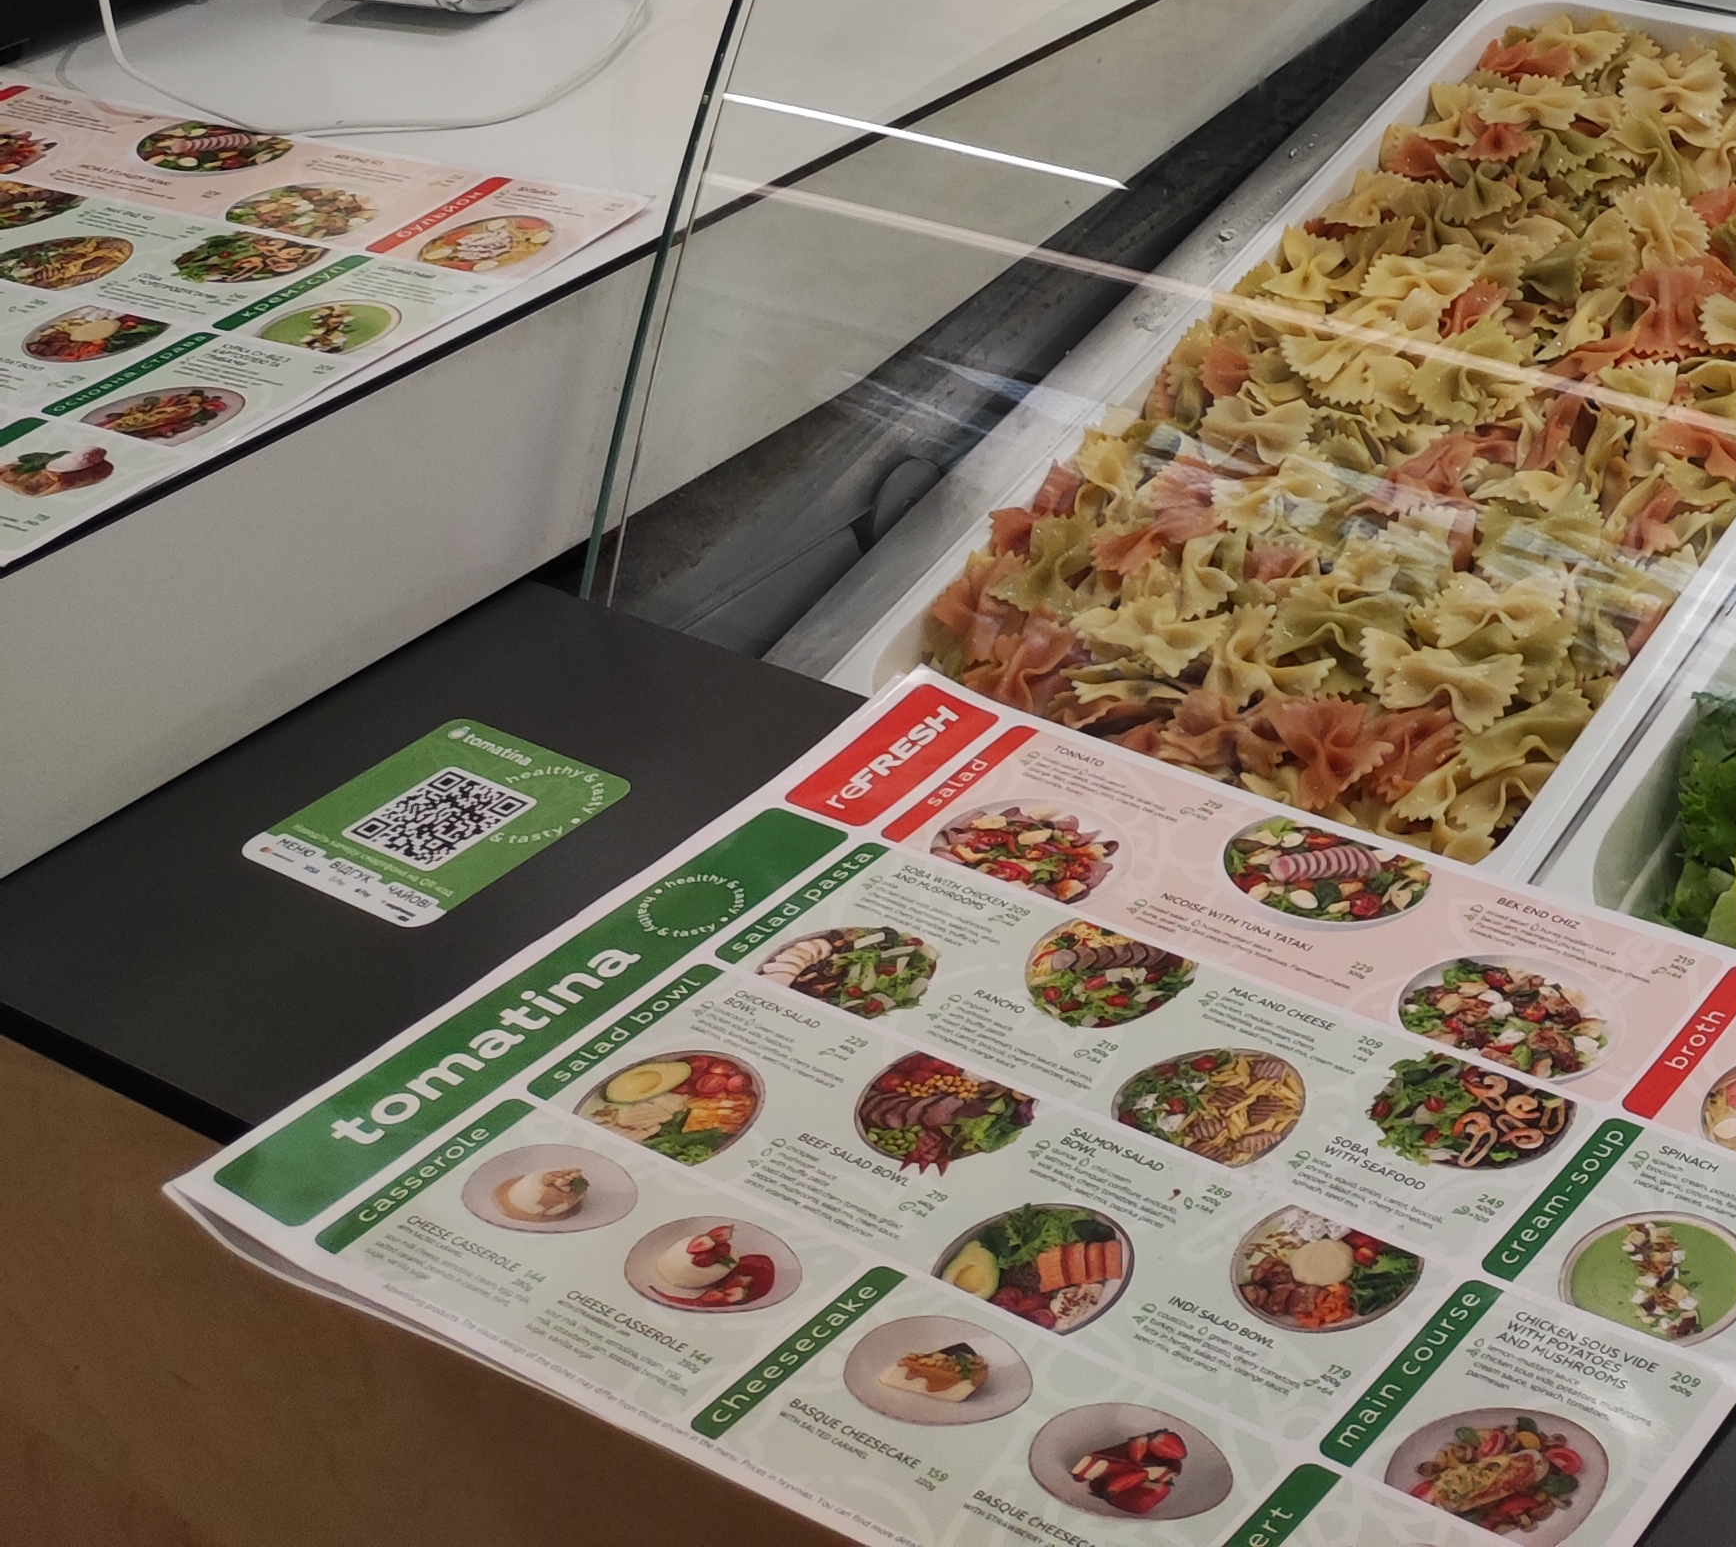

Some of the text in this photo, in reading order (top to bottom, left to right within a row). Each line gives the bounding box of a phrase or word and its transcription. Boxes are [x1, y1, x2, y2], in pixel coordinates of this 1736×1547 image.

[462, 731, 533, 767] tomatina
[1053, 744, 1105, 767] TONNATO
[505, 765, 584, 785] healthy
[926, 758, 989, 807] salad
[276, 837, 317, 859] МЕНЮ
[328, 860, 375, 885] ВІДГУК
[731, 902, 802, 954] salad
[803, 851, 875, 902] pasta
[734, 990, 781, 1013] CHICKEN
[973, 989, 1026, 1014] RANCHO
[1228, 986, 1336, 1031] MAC AND CHEESE
[331, 948, 642, 1146] tomatina
[553, 1026, 631, 1084] salad
[629, 976, 702, 1026] bowl
[1357, 1035, 1384, 1049] 209
[1663, 1010, 1727, 1071] broth
[1331, 1135, 1370, 1156] SOBA
[1658, 1145, 1720, 1173] SPINACH
[357, 1126, 491, 1224] casserole
[1206, 1183, 1233, 1200] 289
[1360, 1159, 1427, 1191] SEAFOOD
[1501, 1129, 1626, 1266] cream-soup
[565, 1289, 689, 1354] CHEESE CASSEROLE
[1237, 1327, 1275, 1350] BOWL
[711, 1283, 879, 1425] cheesecake
[1515, 1311, 1660, 1374] CHICKEN SOUS VIDE
[1547, 1336, 1622, 1373] POTATOES
[1336, 1291, 1483, 1450] main course
[1496, 1332, 1629, 1391] AND MUSHROOMS
[1671, 1370, 1702, 1388] 209
[788, 1397, 922, 1471] BASQUE CHEESECAKE
